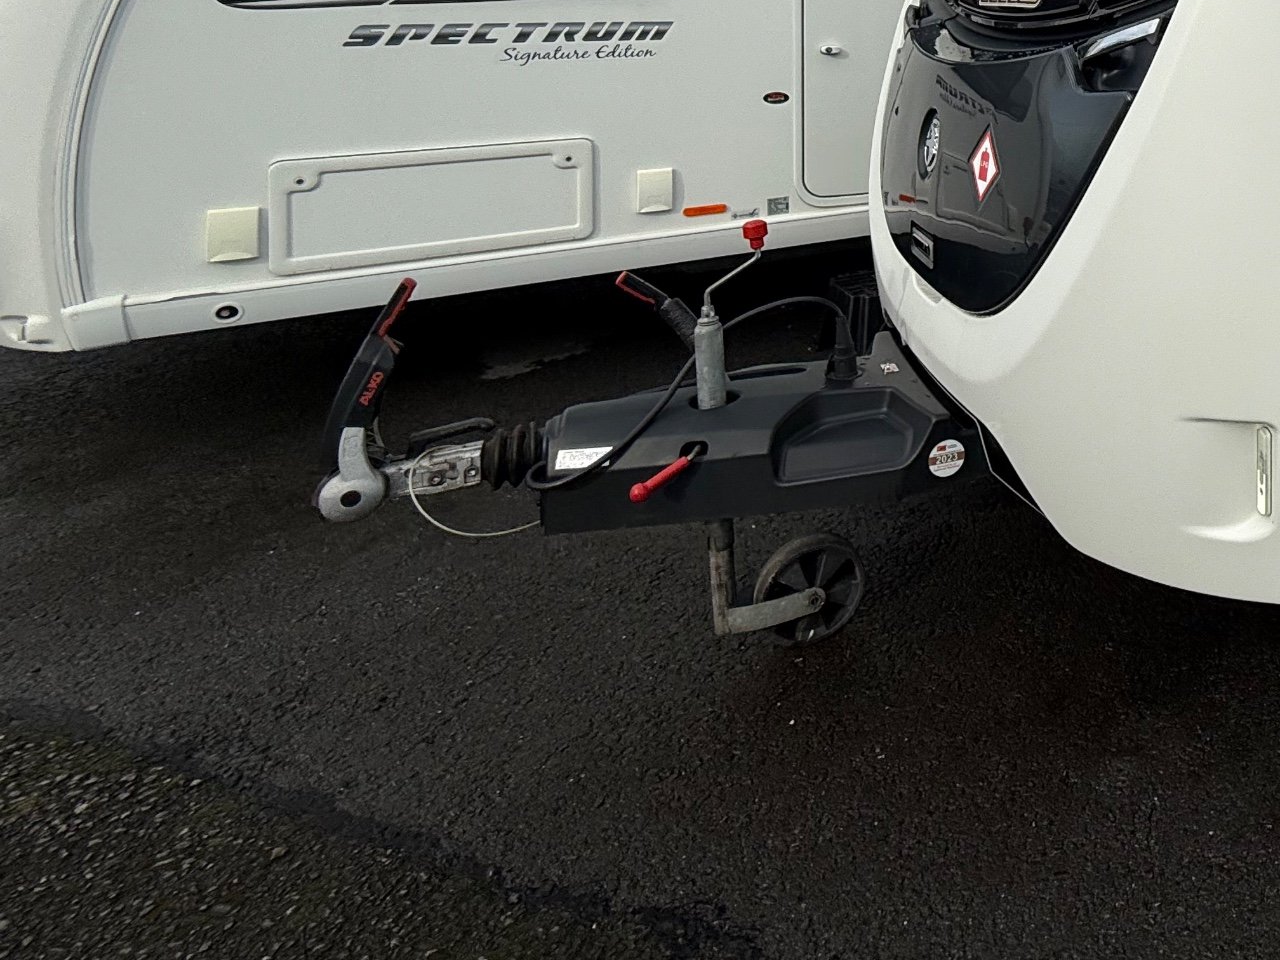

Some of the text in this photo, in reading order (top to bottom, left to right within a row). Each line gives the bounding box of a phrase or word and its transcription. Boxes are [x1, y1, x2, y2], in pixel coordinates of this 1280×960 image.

[342, 21, 674, 48] SPECTRUM
[500, 44, 657, 67] Signature Edition
[935, 452, 959, 465] 2023
